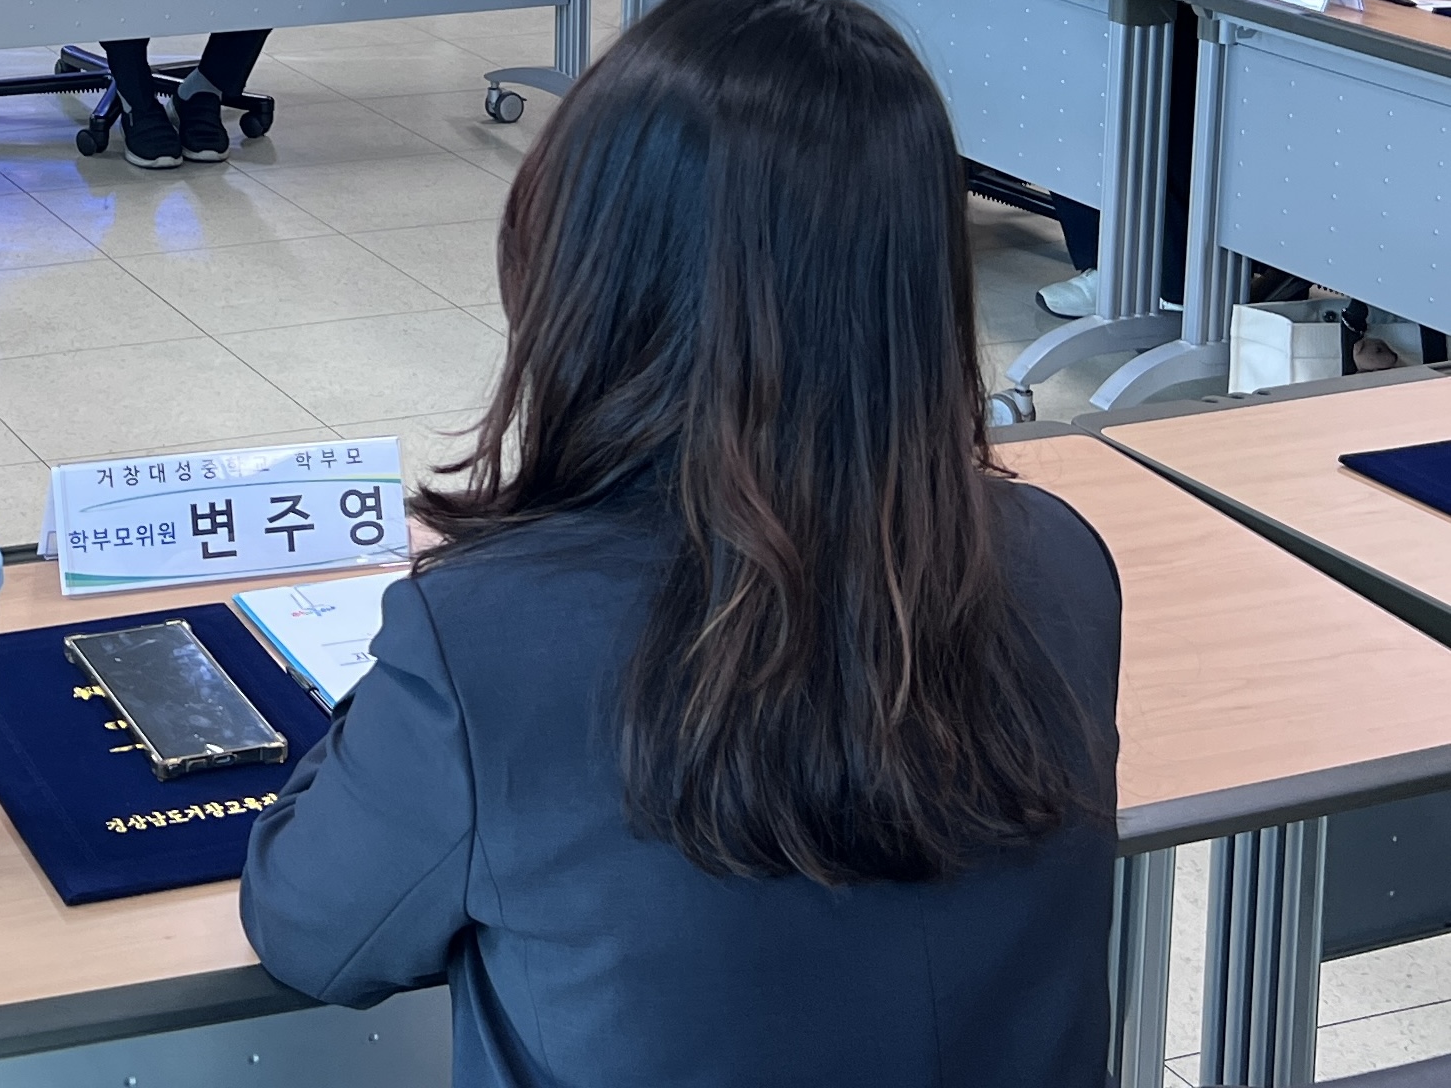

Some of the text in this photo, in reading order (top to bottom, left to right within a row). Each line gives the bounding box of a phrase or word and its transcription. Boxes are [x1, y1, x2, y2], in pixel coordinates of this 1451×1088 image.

[294, 446, 364, 469] 학부모
[67, 485, 386, 561] 학부모위원 변주영
